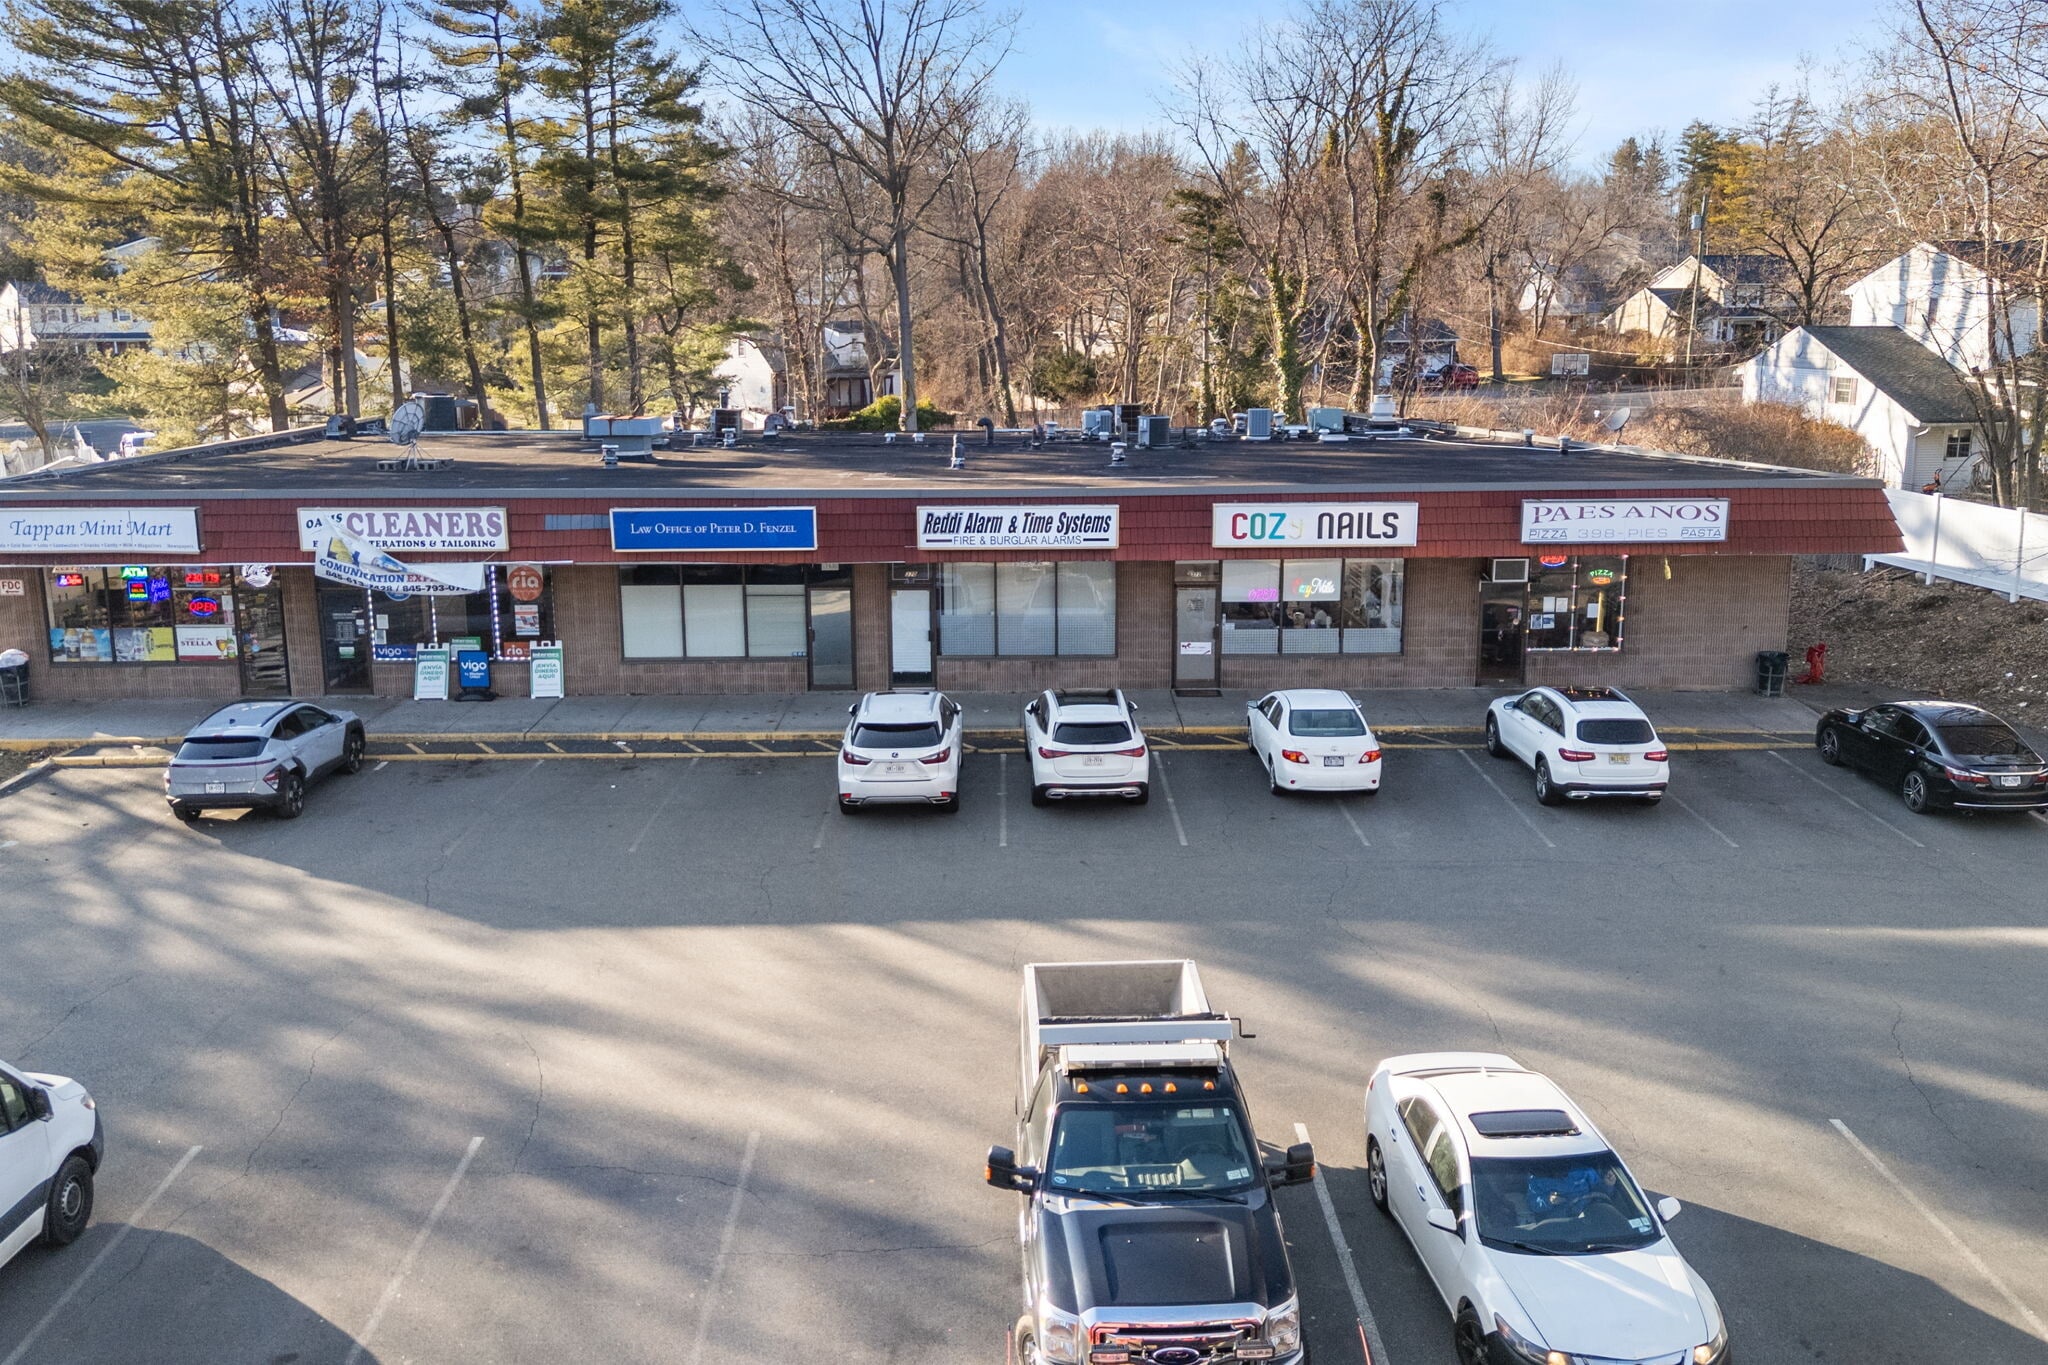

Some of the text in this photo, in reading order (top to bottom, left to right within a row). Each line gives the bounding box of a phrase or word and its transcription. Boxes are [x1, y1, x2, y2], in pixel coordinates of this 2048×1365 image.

[346, 512, 503, 538] CLEANERS
[744, 523, 757, 534] D.
[923, 511, 1112, 535] Reddi Alarm & Time Systems
[1317, 512, 1399, 539] NAILS
[10, 520, 172, 541] Tappan Mini Mart
[1529, 529, 1567, 539] PIZZA
[1680, 528, 1721, 538] PASTA
[429, 540, 437, 548] &
[441, 540, 496, 548] TAILORING
[954, 535, 1082, 545] FIRE & BURGLAR ALARMS
[122, 567, 148, 578] ATM
[1589, 569, 1614, 577] PIZZA
[1, 581, 21, 590] FDC
[512, 571, 539, 589] ria
[189, 601, 217, 612] OPEN
[378, 645, 402, 657] vigo
[507, 645, 522, 655] ria
[460, 659, 487, 672] vigo
